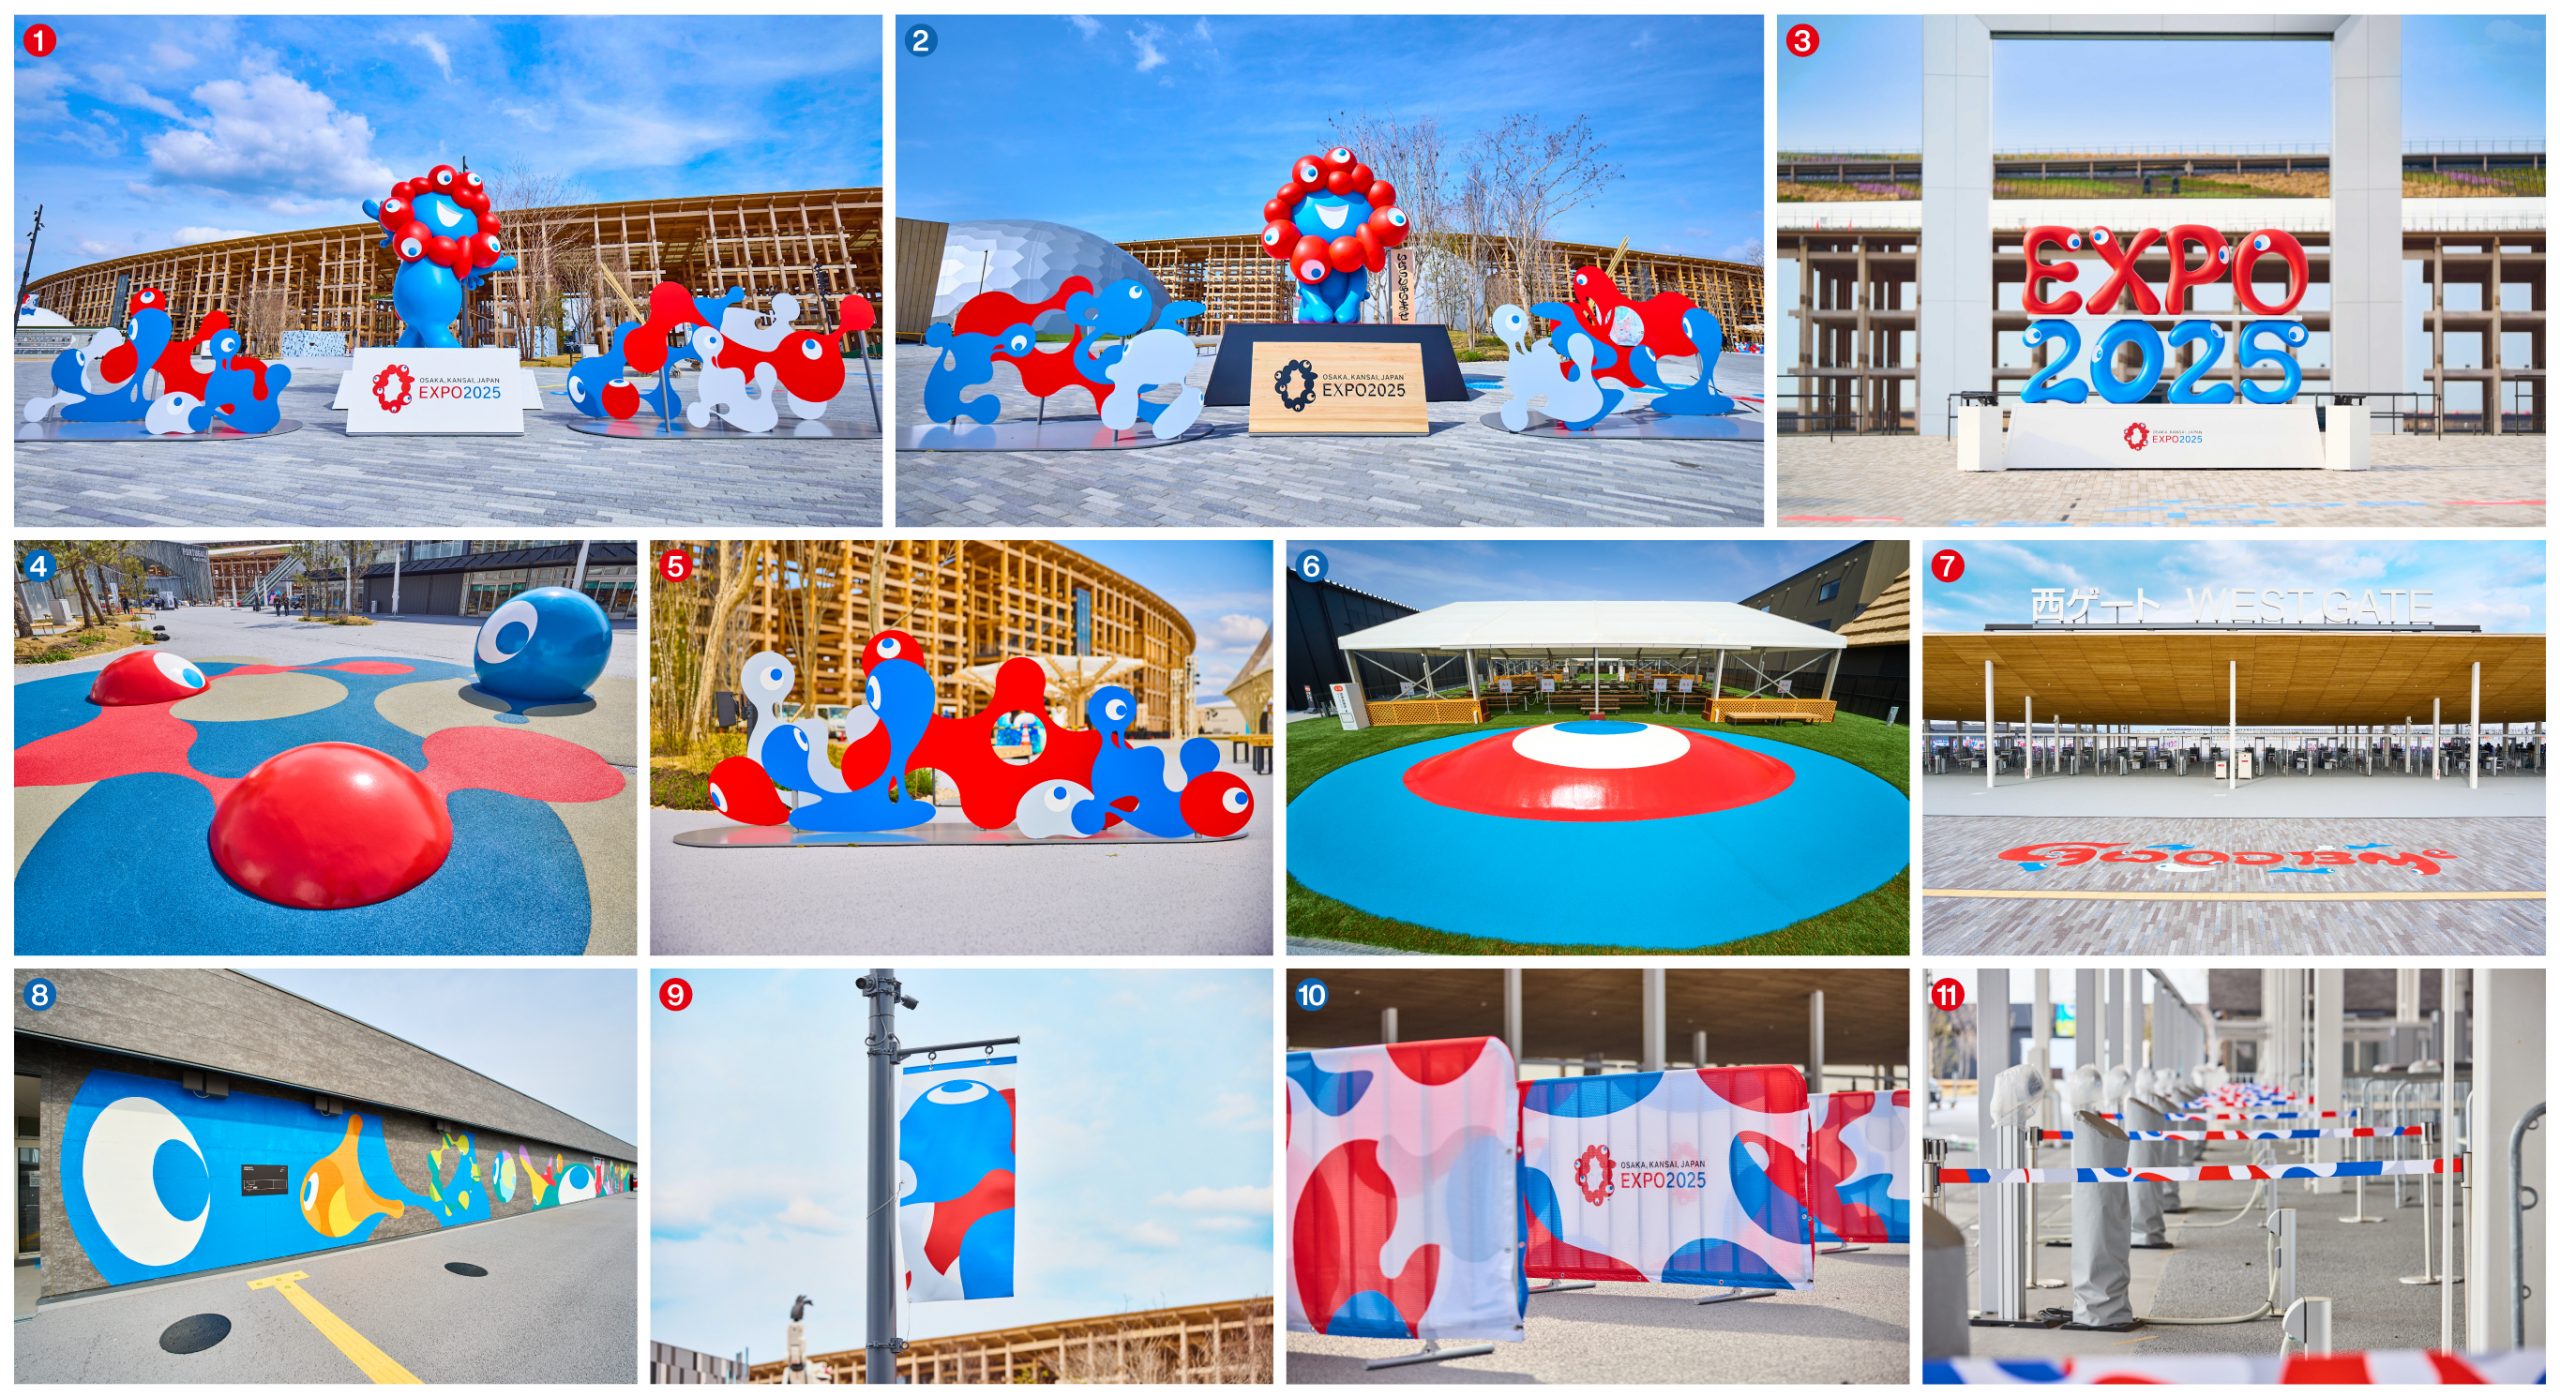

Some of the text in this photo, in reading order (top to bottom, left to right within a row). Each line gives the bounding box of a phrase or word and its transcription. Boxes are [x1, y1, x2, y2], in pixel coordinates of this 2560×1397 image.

[2022, 224, 2309, 315] EXPO
[2020, 319, 2309, 404] 2025
[419, 377, 446, 385] OSAKA,
[1322, 373, 1350, 381] OSAKA,
[1381, 373, 1404, 381] JAPAN
[419, 385, 501, 399] EXPO2025
[1322, 383, 1406, 397] EXPO2025
[2152, 435, 2203, 444] EXPO2025
[2031, 587, 2160, 621] 西ゲート
[2186, 587, 2433, 622] WEST GATE
[1620, 1160, 1706, 1169] OSAKA, KANSAI, JAPAN
[1620, 1172, 1707, 1189] EXPO2025
